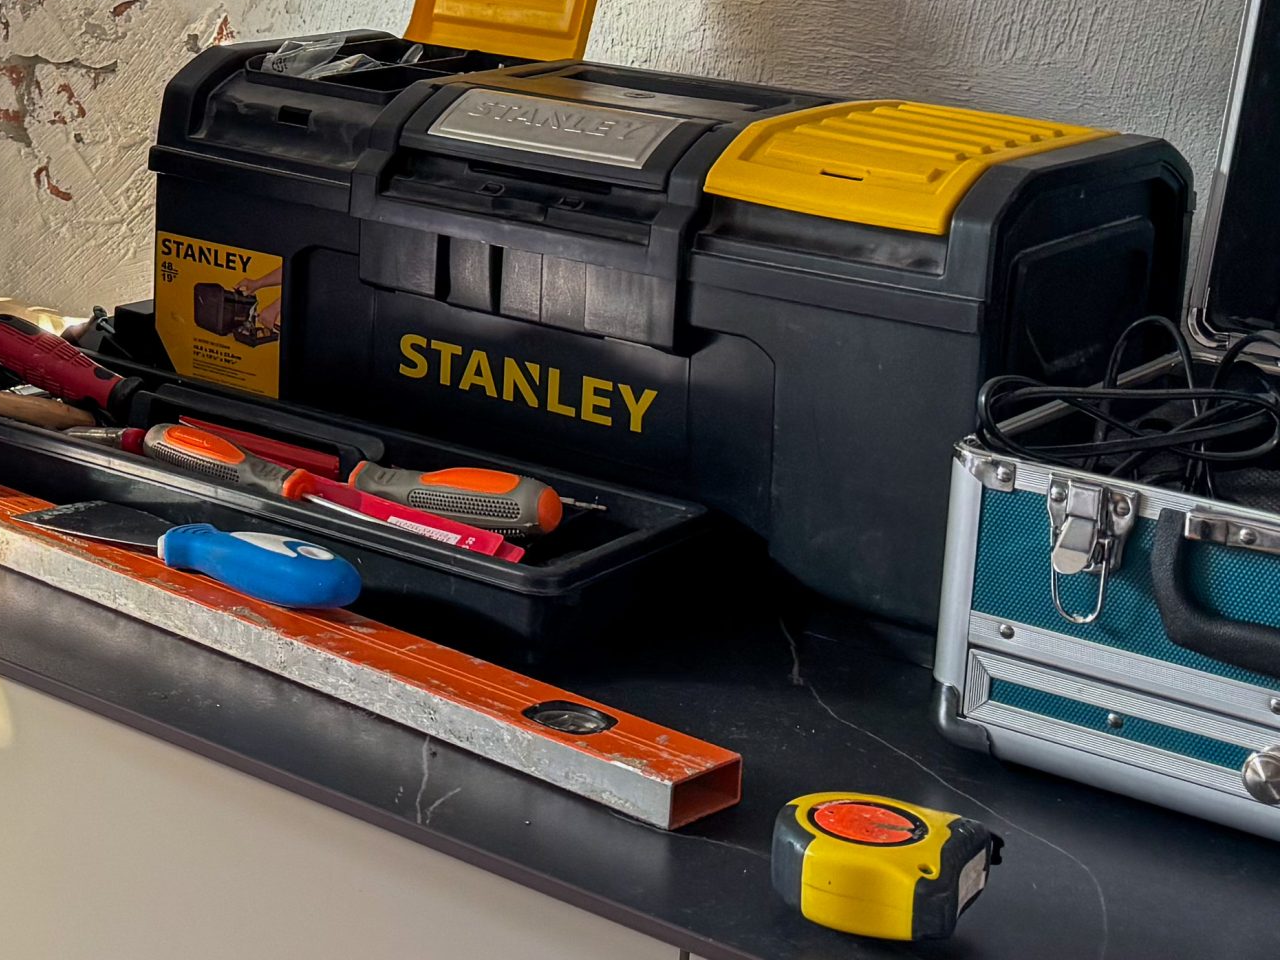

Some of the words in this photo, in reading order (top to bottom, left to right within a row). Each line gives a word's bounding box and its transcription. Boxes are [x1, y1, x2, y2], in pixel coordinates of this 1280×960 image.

[467, 101, 647, 141] STANLEY
[161, 238, 252, 273] STANLEY
[398, 333, 658, 433] STANLEY
